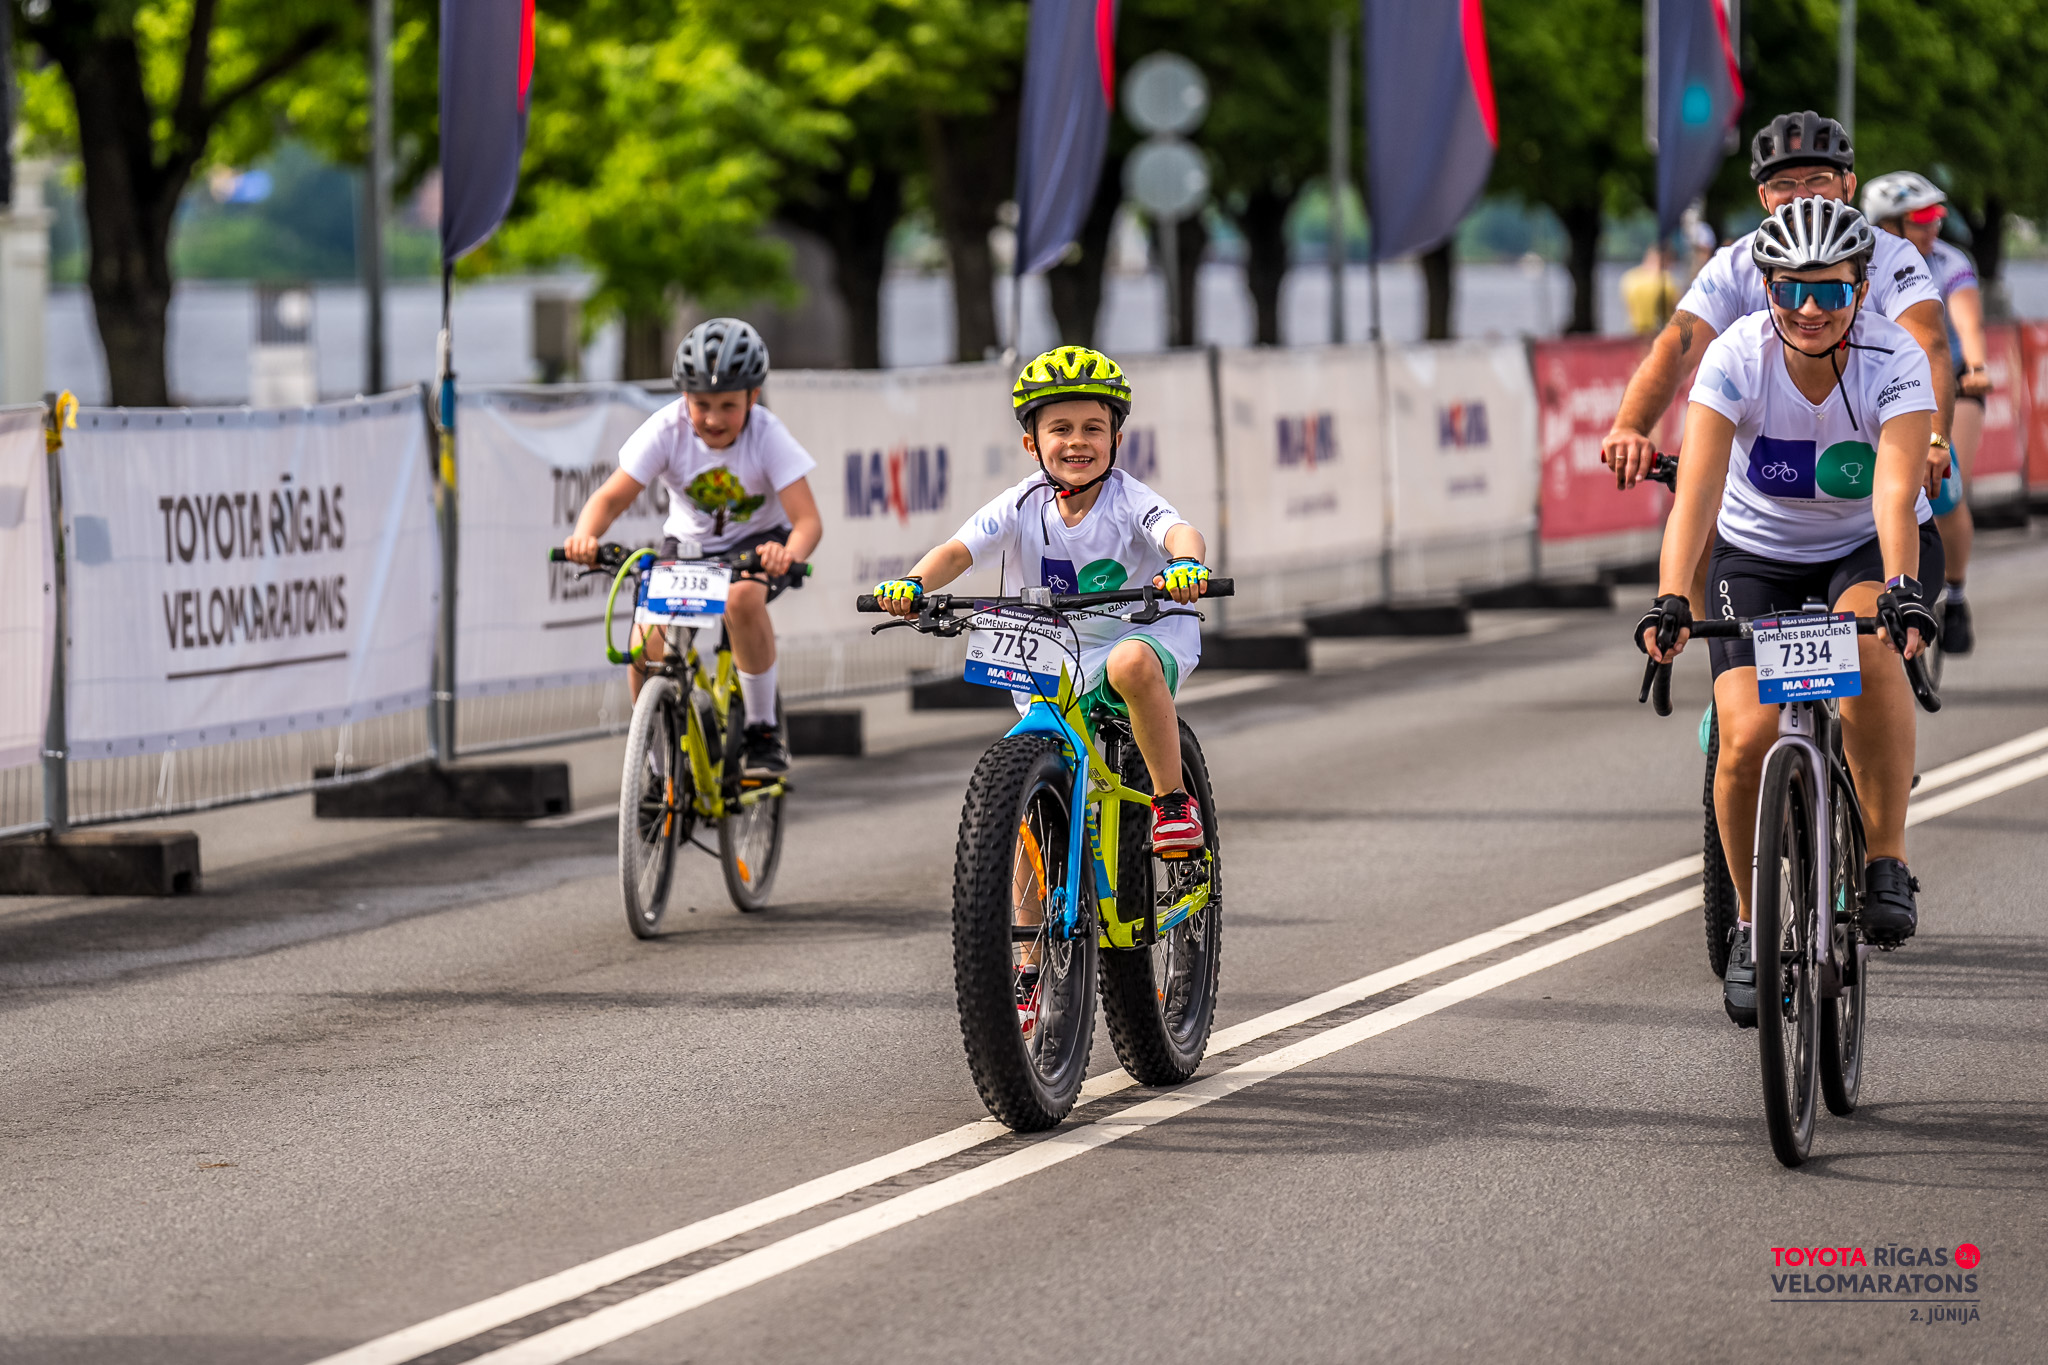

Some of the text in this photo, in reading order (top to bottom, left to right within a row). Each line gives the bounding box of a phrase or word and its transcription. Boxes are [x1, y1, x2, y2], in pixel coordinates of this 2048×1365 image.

[160, 473, 346, 564] TOYOTA RĪGAS
[671, 576, 708, 590] 7338
[163, 575, 348, 650] VELOMARATONS
[1719, 580, 1736, 621] orc
[1800, 626, 1851, 639] BRAUCIENS
[991, 632, 1039, 662] 7752
[1779, 640, 1832, 667] 7334
[987, 667, 1034, 684] MAXIMA
[1782, 677, 1835, 691] MAXIMA
